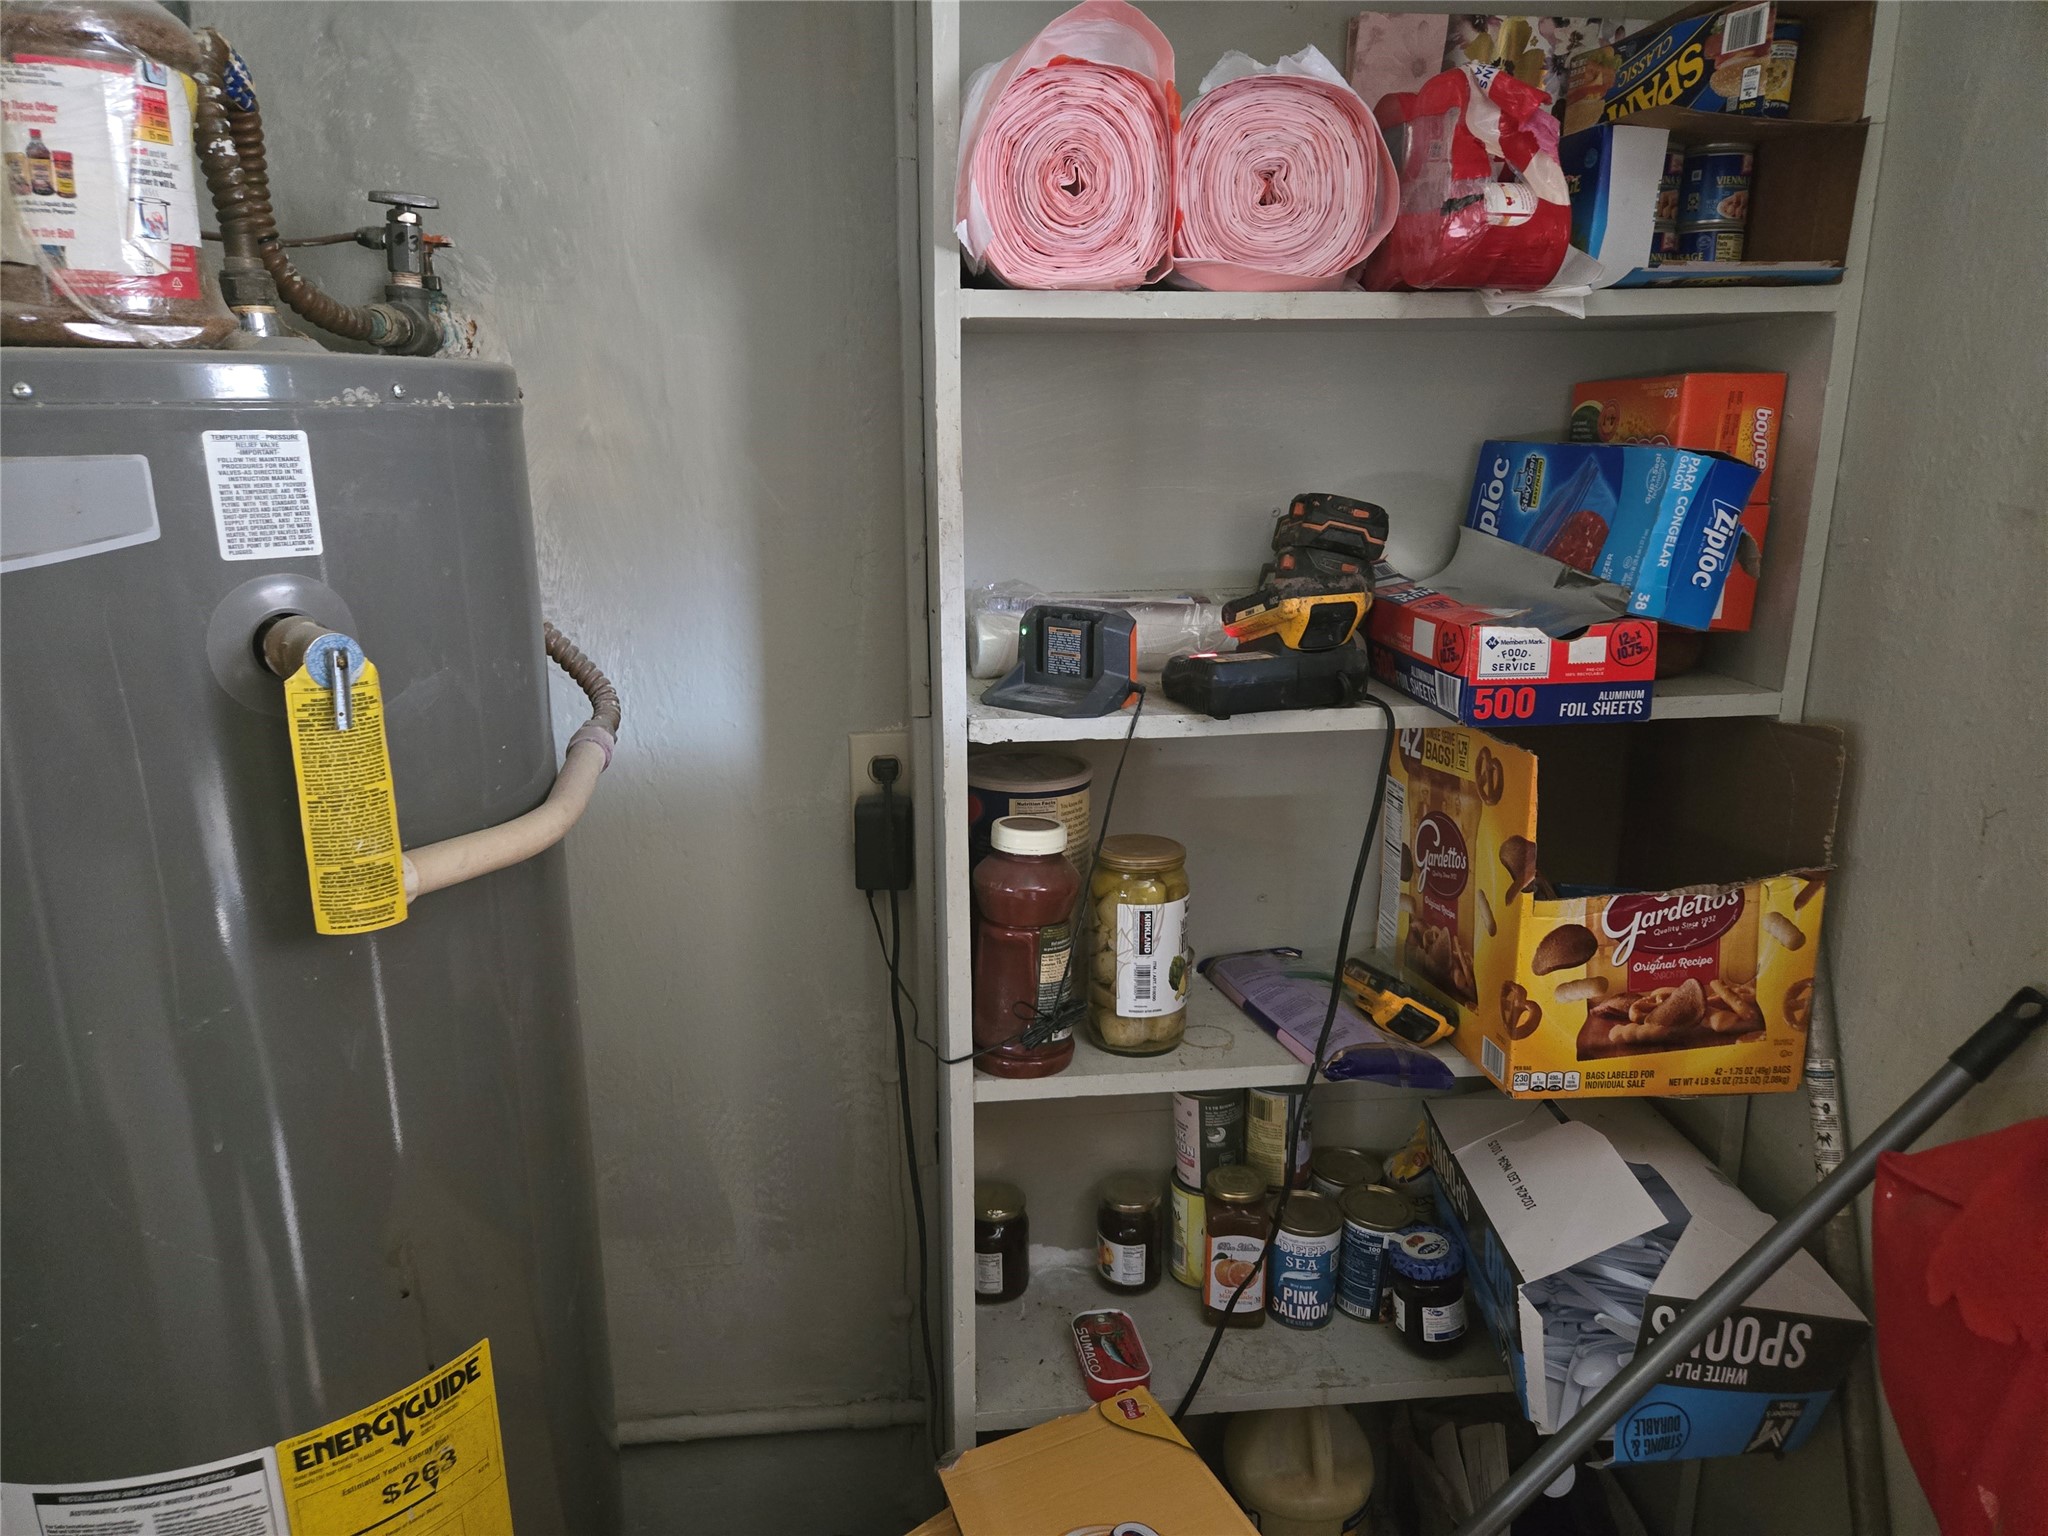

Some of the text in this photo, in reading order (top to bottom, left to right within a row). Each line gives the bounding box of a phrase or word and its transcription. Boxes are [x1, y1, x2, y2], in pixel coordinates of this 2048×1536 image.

[1618, 36, 1673, 88] CLASSIC
[1607, 43, 1704, 121] SPAM
[1664, 388, 1678, 398] 160
[1752, 406, 1774, 471] bounce
[1658, 456, 1701, 568] PARA CONGELAR
[1691, 508, 1739, 588] Ziploc
[1634, 592, 1651, 610] 38
[1502, 648, 1528, 659] FOOD
[1491, 662, 1536, 672] SERVICE
[1410, 677, 1437, 706] SHEETS
[1473, 686, 1536, 720] 500
[1598, 690, 1645, 700] ALUMINUM
[1559, 700, 1644, 717] FOIL SHEETS
[1400, 728, 1422, 760] 42
[1426, 740, 1454, 768] BAGS!
[1414, 819, 1467, 894] Gardetto's
[1144, 912, 1152, 954] KIRKLAND
[1601, 890, 1739, 966] Gardettos
[1654, 926, 1680, 936] Quality
[1632, 956, 1714, 974] Original Recipe
[1514, 1074, 1528, 1082] 230
[1586, 1070, 1654, 1080] BAGS LABELED FOR
[1668, 1078, 1681, 1086] NET
[1682, 1078, 1693, 1086] WT
[1694, 1077, 1700, 1086] 4
[1700, 1077, 1709, 1086] LB
[1710, 1076, 1720, 1085] 9.5
[1722, 1076, 1732, 1085] OZ
[1714, 1067, 1723, 1076] 42
[1730, 1066, 1743, 1075] 1.75
[1744, 1066, 1754, 1074] OZ
[1773, 1065, 1791, 1074] BAGS
[1585, 1080, 1646, 1089] INDIVIDUAL SALE
[1515, 1184, 1536, 1210] 102424
[1280, 1240, 1327, 1258] DEEP
[1286, 1256, 1318, 1270] SEA
[1283, 1286, 1318, 1305] PINK
[1272, 1296, 1328, 1320] SALMON
[1646, 1305, 1812, 1369] SPOOS
[1076, 1327, 1102, 1373] SUMACO
[1703, 1364, 1748, 1385] WHITE
[292, 1356, 481, 1473] ENERGYGUIDE
[1634, 1414, 1681, 1437] DURABLE
[1630, 1432, 1683, 1458] STRONG &
[382, 1447, 458, 1504] $263
